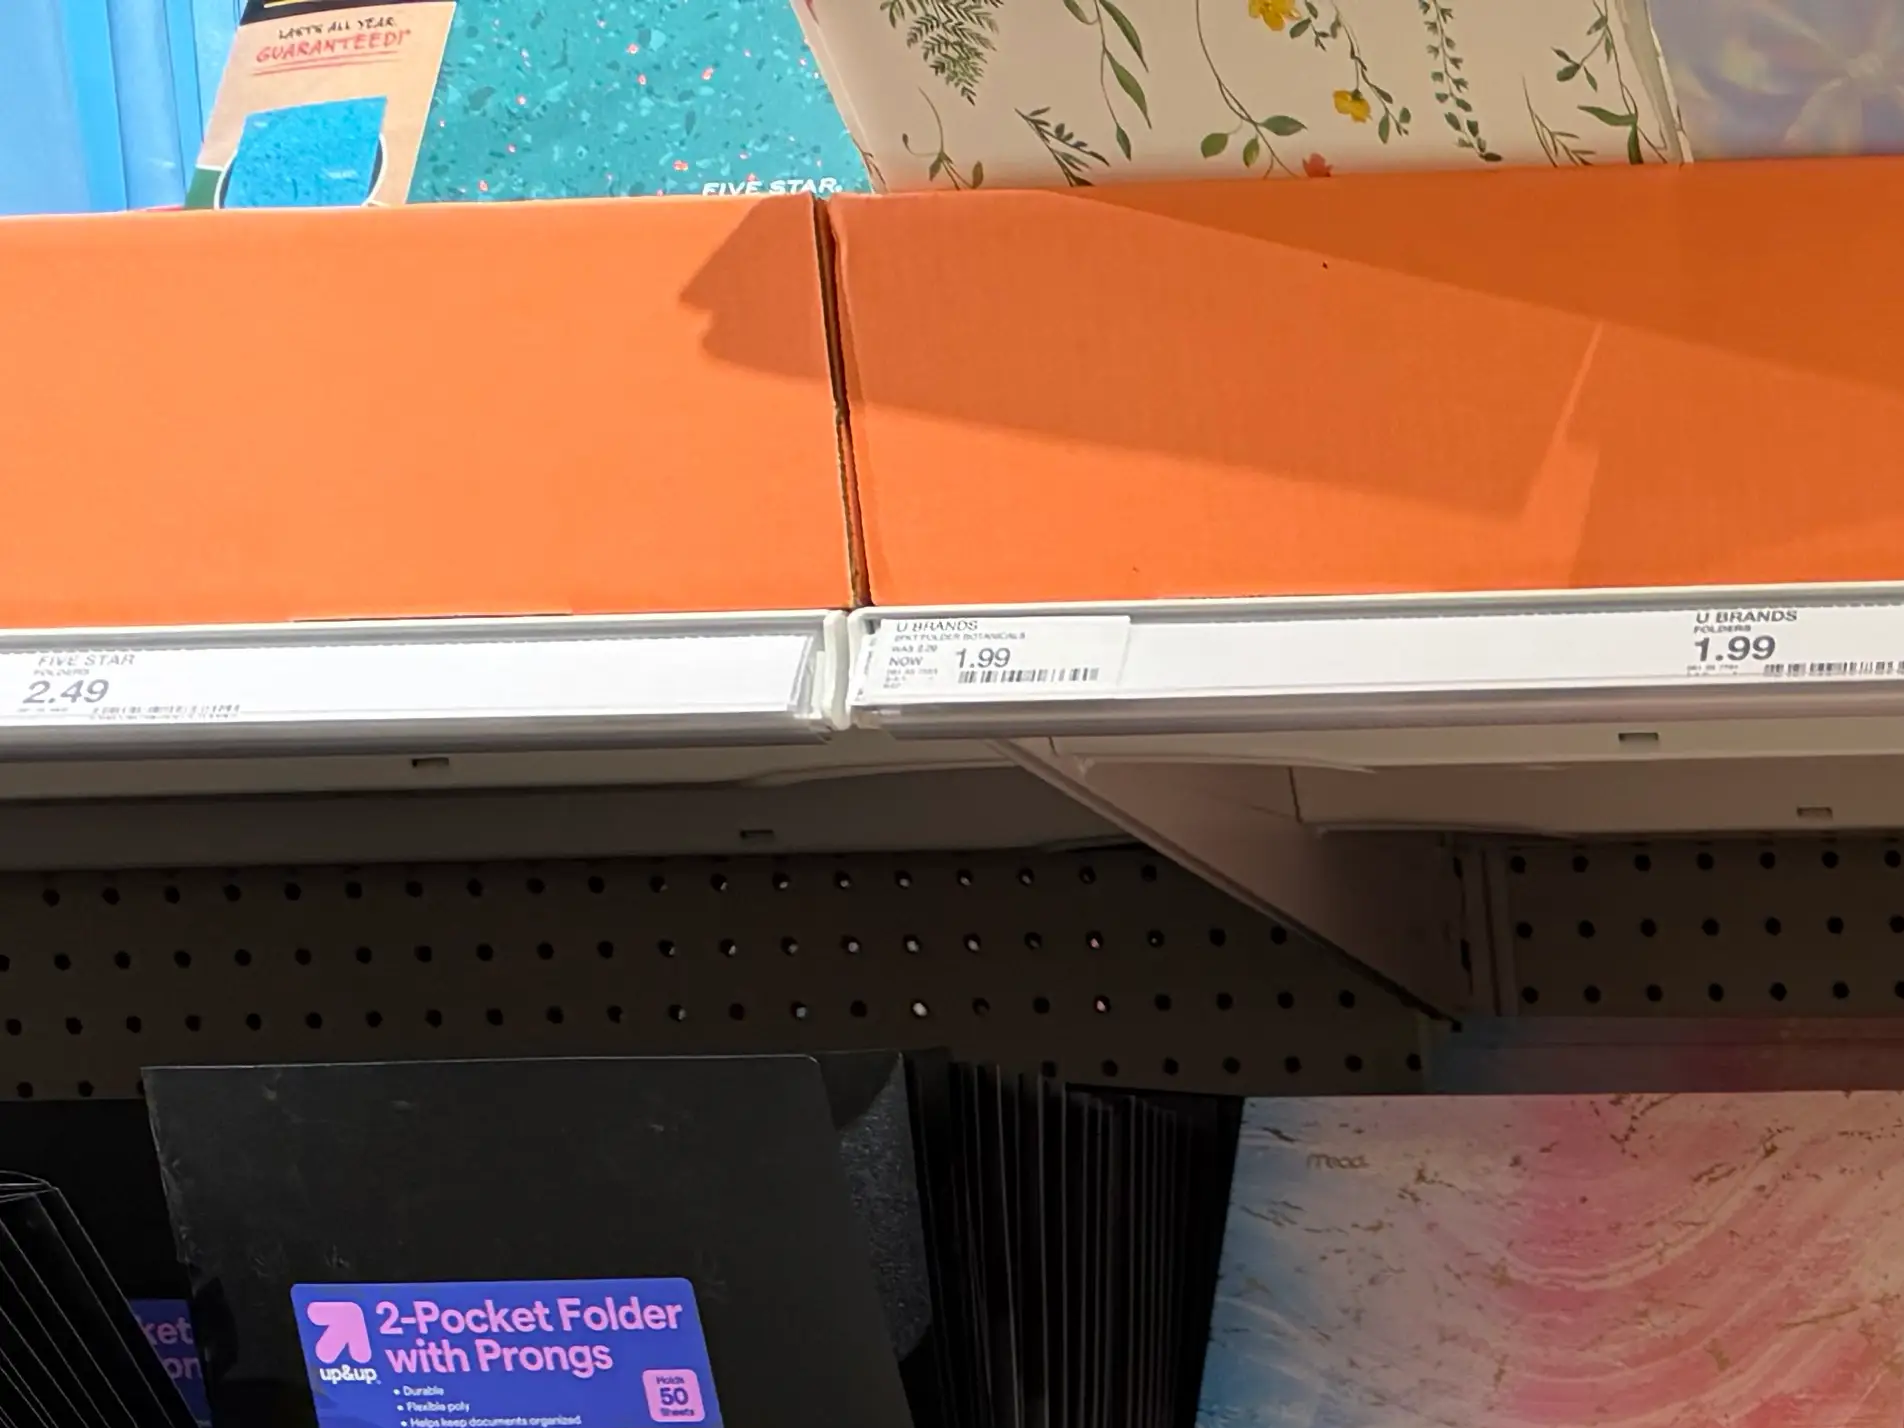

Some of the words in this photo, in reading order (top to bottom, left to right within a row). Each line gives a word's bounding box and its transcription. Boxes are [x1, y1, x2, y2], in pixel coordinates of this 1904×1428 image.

[702, 181, 763, 196] FIVE
[911, 620, 978, 632] BRANDS
[1696, 611, 1711, 624] U
[1715, 610, 1798, 623] BRANDS
[955, 647, 1011, 668] 1.99
[1694, 635, 1776, 662] 1.99
[38, 654, 78, 667] FIVE
[84, 654, 136, 667] STAR
[889, 656, 923, 667] NOW
[23, 679, 109, 704] 2.49
[375, 1298, 552, 1335] 2-Pocket
[557, 1296, 683, 1331] Folder
[385, 1339, 469, 1373] with
[475, 1340, 613, 1378] Prongs
[320, 1363, 377, 1385] up&up
[660, 1388, 688, 1405] 50
